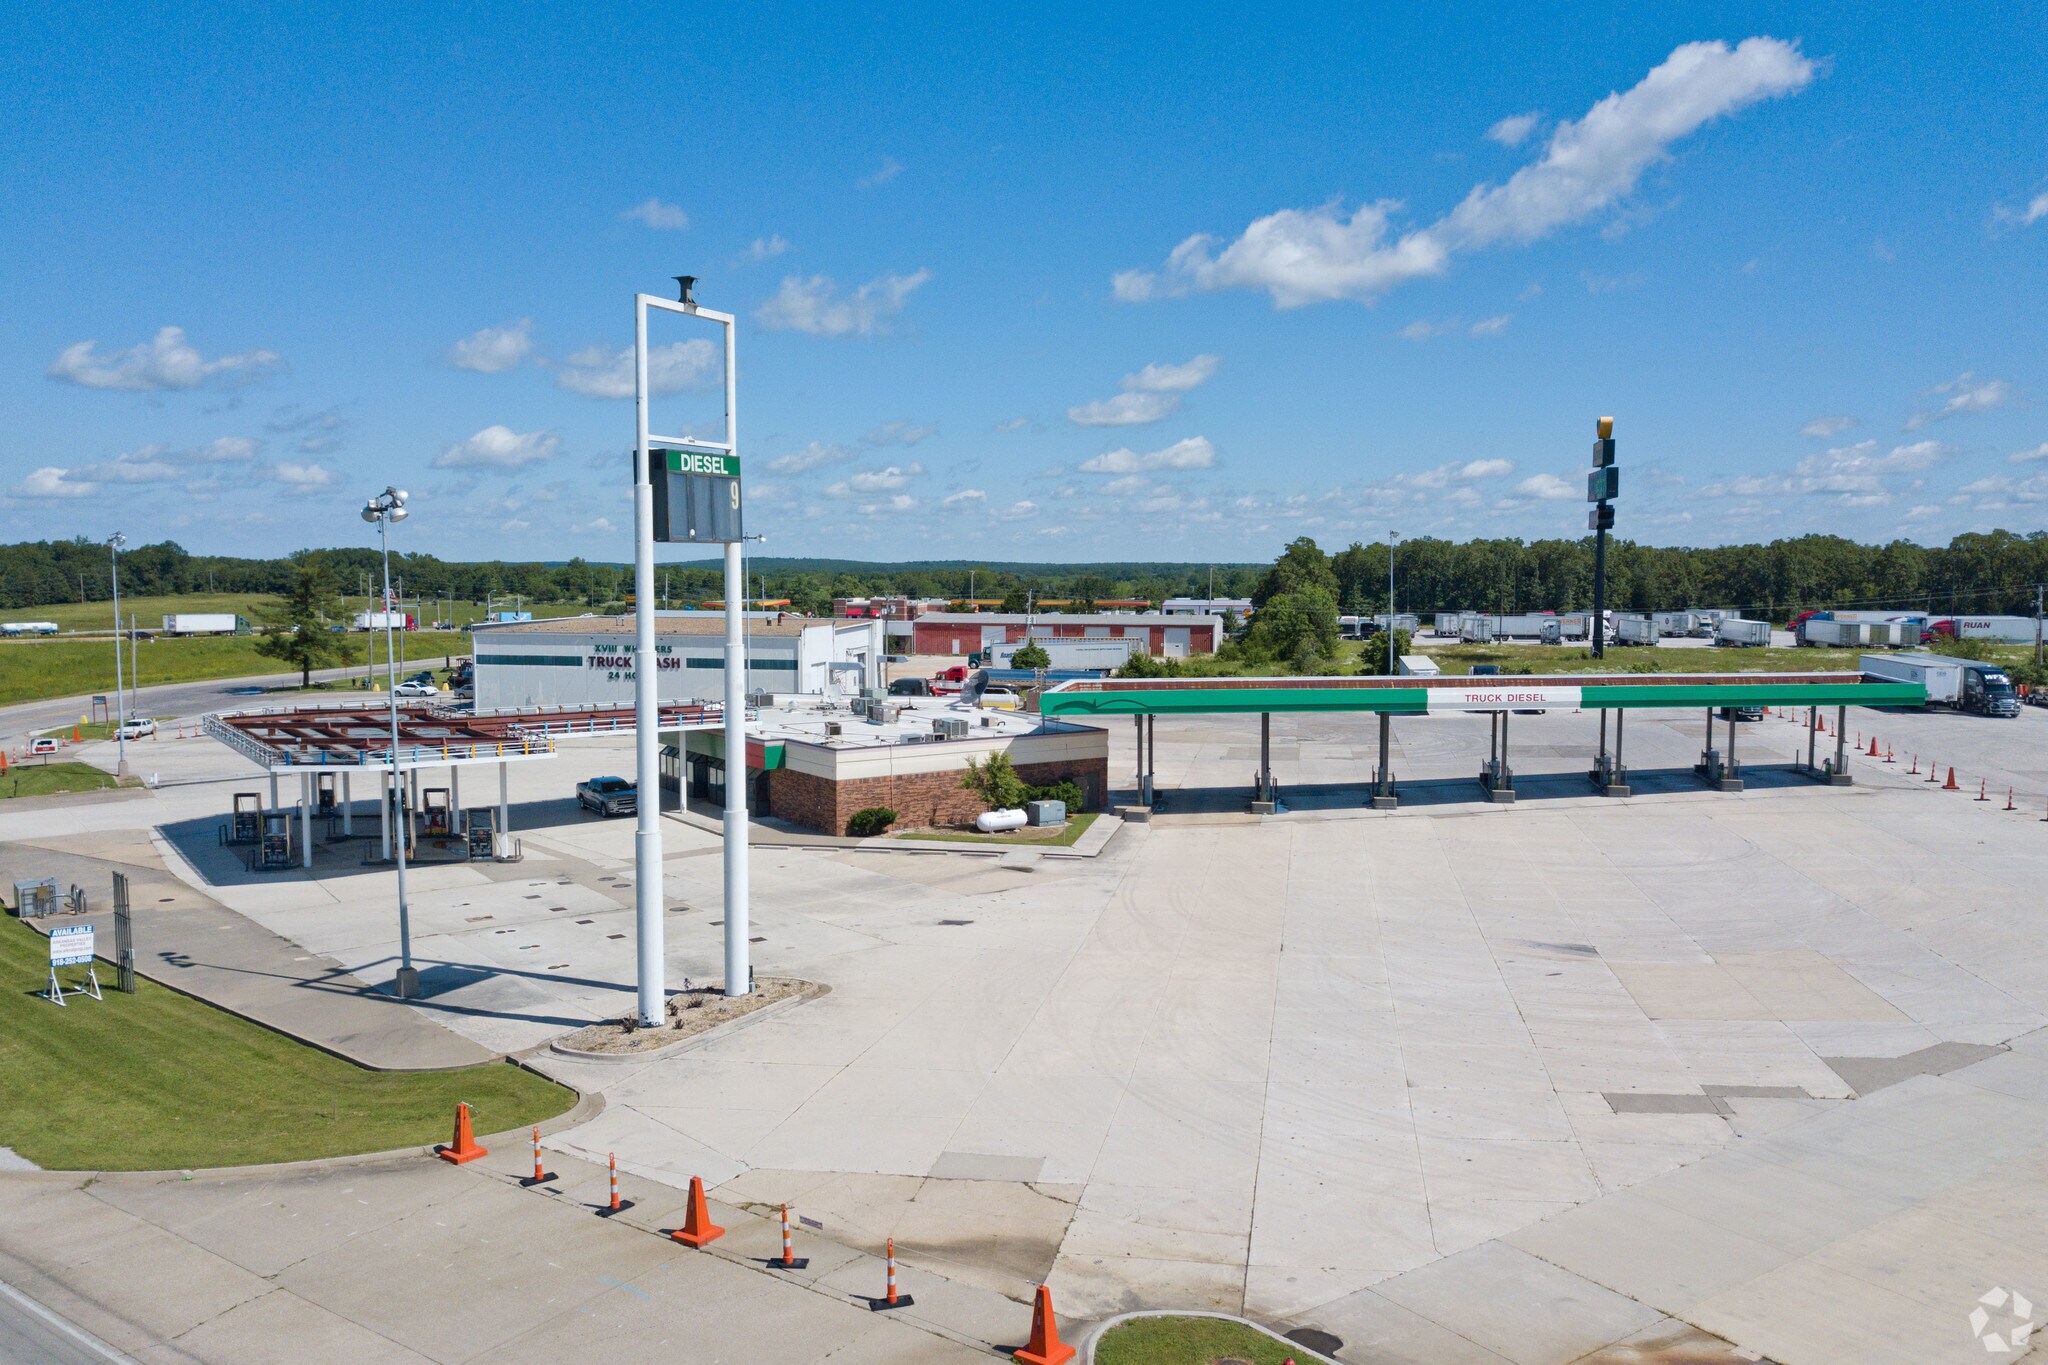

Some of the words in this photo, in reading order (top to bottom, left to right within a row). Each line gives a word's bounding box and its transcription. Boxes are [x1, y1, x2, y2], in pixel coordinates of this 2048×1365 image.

[681, 454, 729, 475] DIESEL
[730, 481, 740, 510] 9
[1963, 621, 1991, 629] RUAN
[594, 645, 617, 653] XVIII
[623, 645, 672, 654] WHERS
[588, 656, 632, 668] TRUCK
[656, 657, 681, 669] ASH
[608, 671, 620, 679] 24
[1465, 694, 1502, 702] TRUCK
[1507, 694, 1546, 702] DIESEL
[52, 926, 92, 937] AVAILABLE
